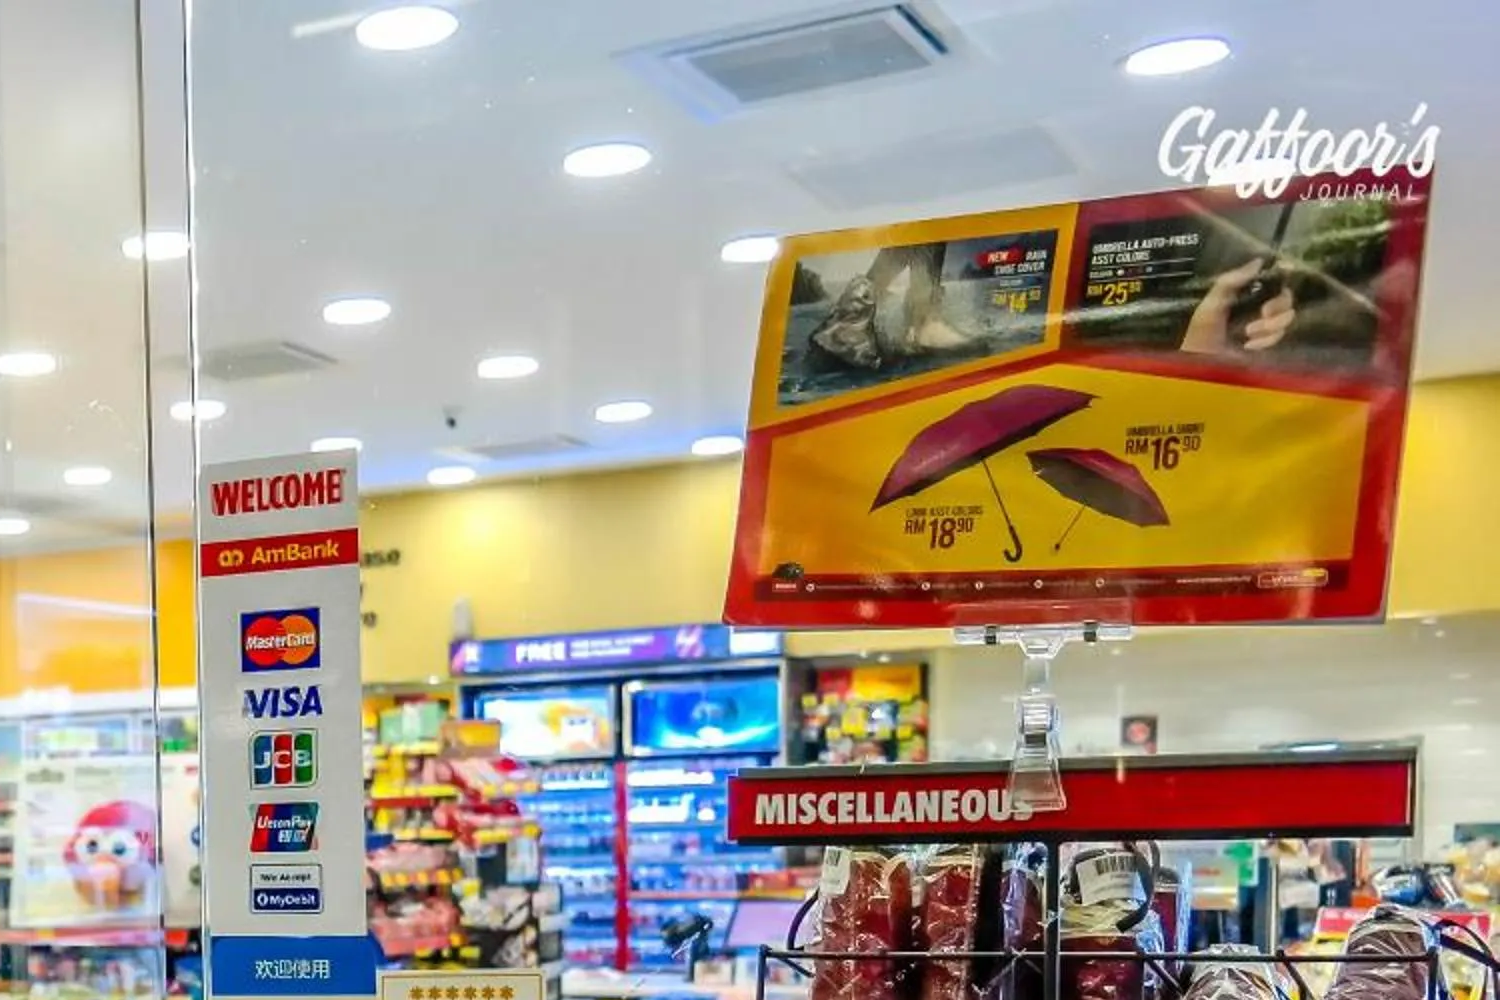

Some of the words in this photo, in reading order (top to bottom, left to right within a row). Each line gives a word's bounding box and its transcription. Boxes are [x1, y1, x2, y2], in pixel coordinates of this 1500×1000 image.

[1125, 438, 1150, 455] RM
[211, 468, 344, 517] WELCOME
[904, 519, 926, 535] RM
[251, 538, 340, 565] AmBank
[246, 632, 316, 651] MasterCard
[243, 685, 323, 719] VISA
[253, 749, 314, 769] JCB
[269, 893, 316, 907] MyDebit
[255, 958, 331, 980] 欢迎使用
